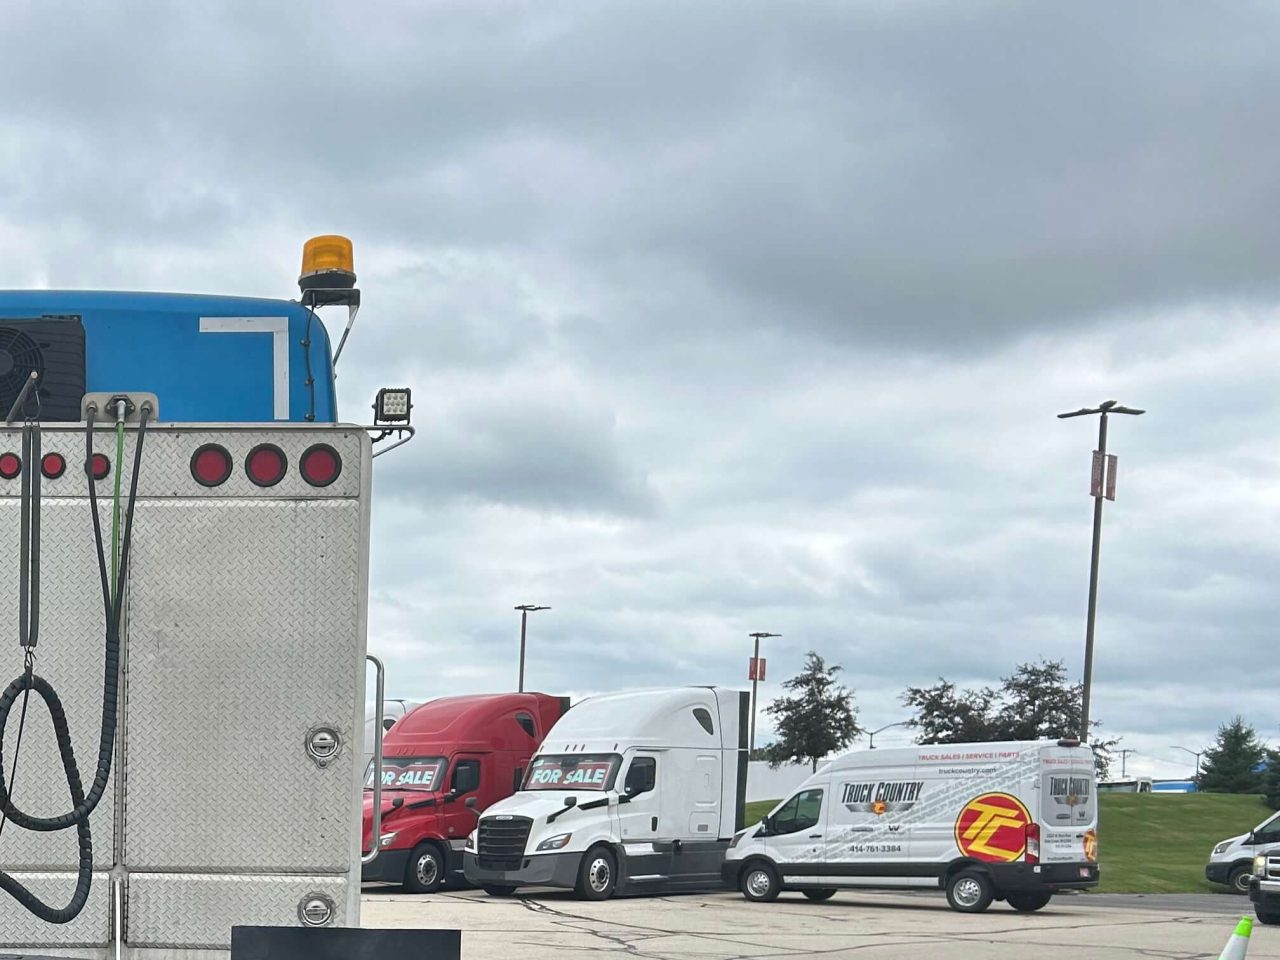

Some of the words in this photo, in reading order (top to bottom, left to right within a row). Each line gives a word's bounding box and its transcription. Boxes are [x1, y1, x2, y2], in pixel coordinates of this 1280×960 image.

[965, 752, 993, 760] SERVICE
[998, 751, 1020, 759] PARTS
[367, 770, 396, 786] FR
[395, 770, 434, 786] SALE
[531, 768, 563, 784] FOR
[562, 768, 606, 785] SALE
[841, 783, 876, 804] TRUCK
[875, 781, 924, 803] COUNTRY
[849, 844, 902, 853] 414-761-3384
